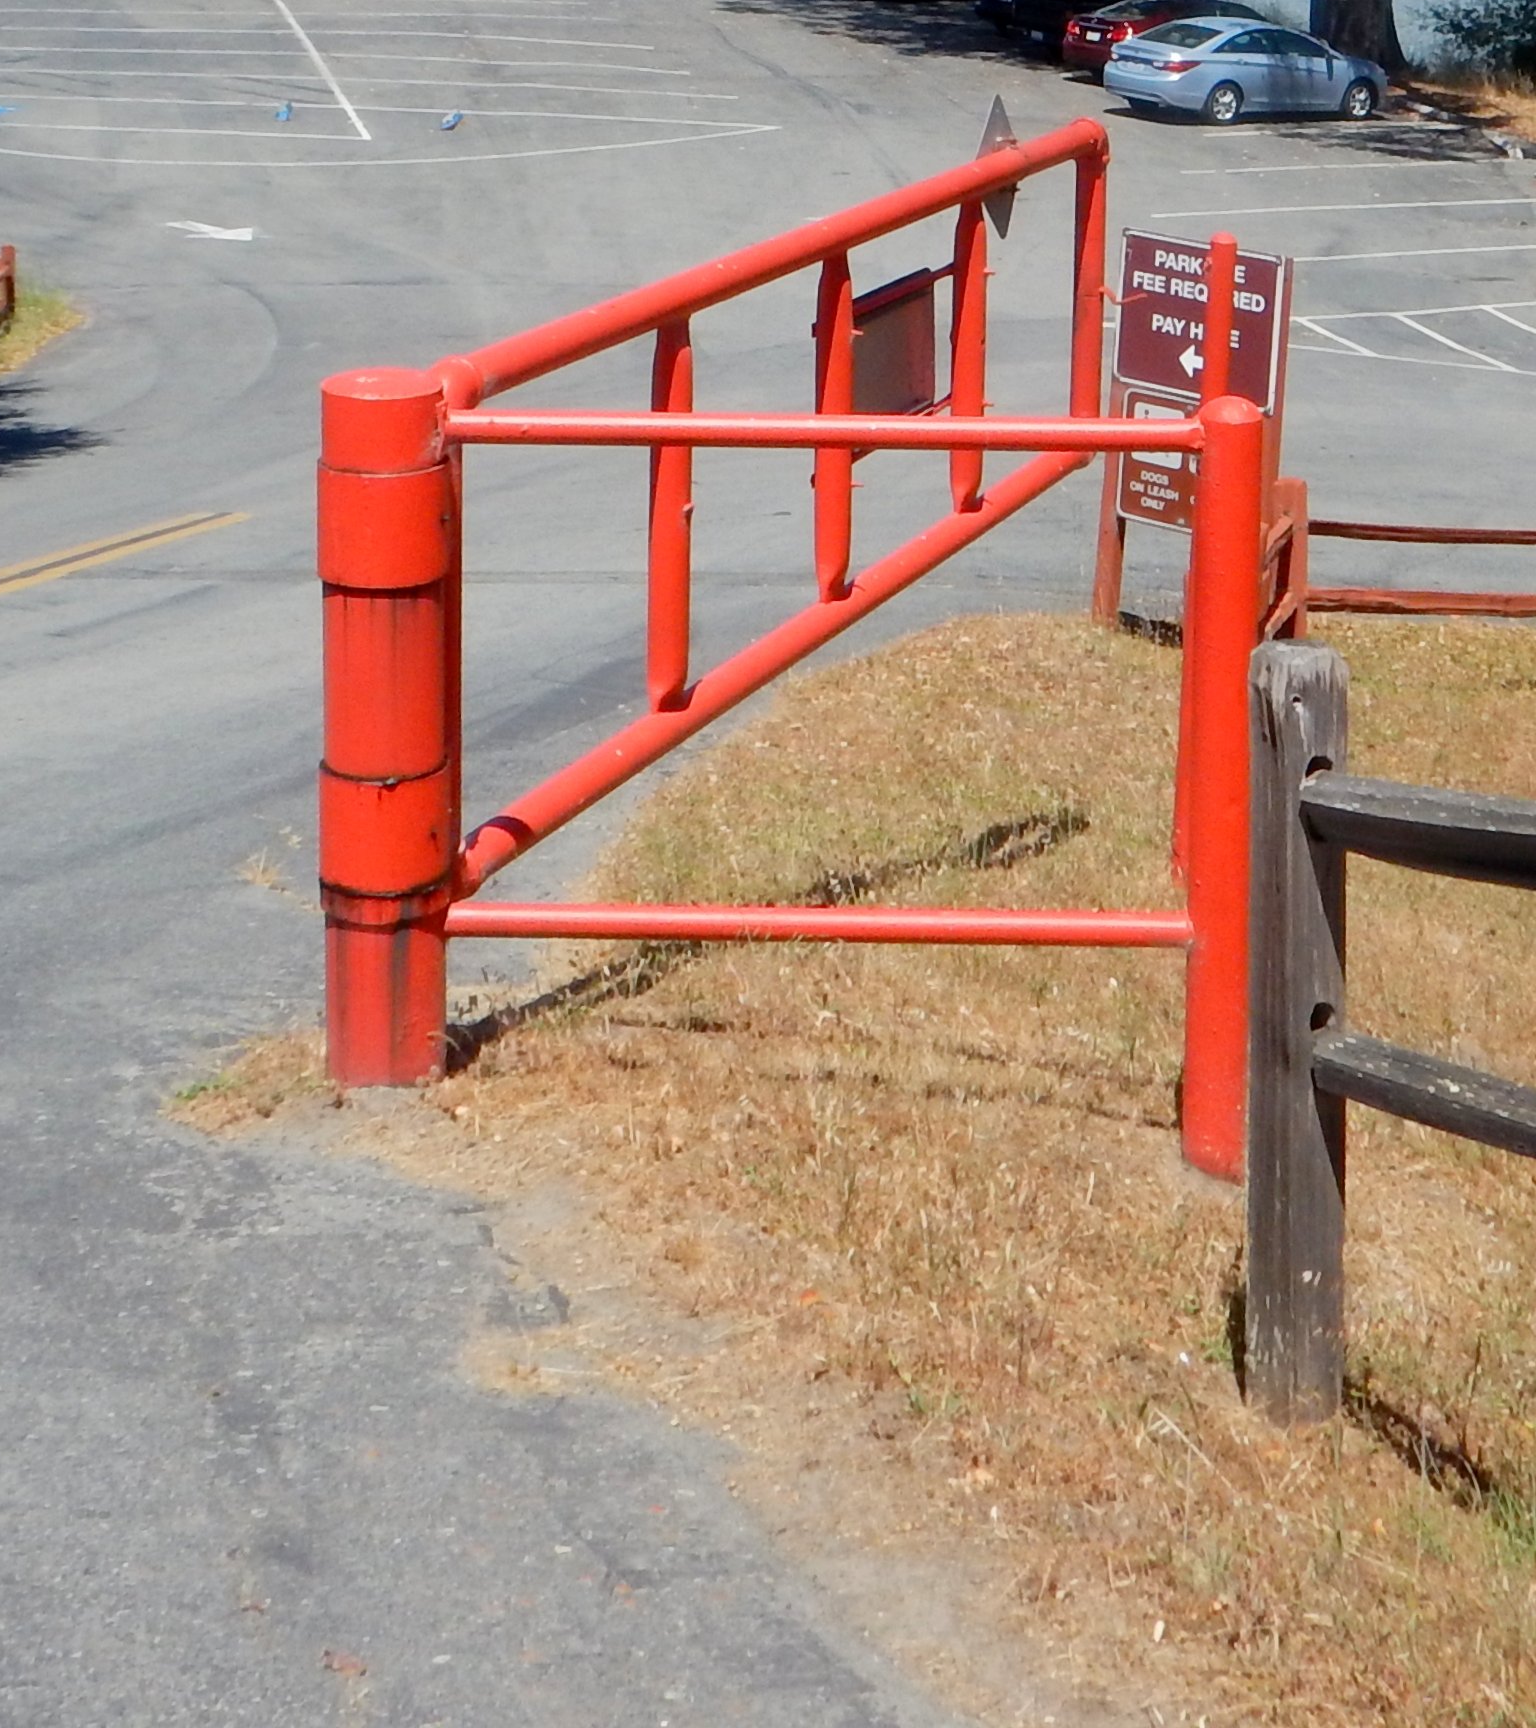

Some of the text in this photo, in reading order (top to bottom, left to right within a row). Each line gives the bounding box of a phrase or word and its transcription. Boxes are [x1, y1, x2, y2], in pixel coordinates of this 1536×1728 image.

[1132, 270, 1166, 294] FEE
[1151, 313, 1240, 349] PAY HE
[1141, 470, 1169, 485] DOGS
[1129, 480, 1145, 493] ON
[1147, 484, 1179, 501] LEASH
